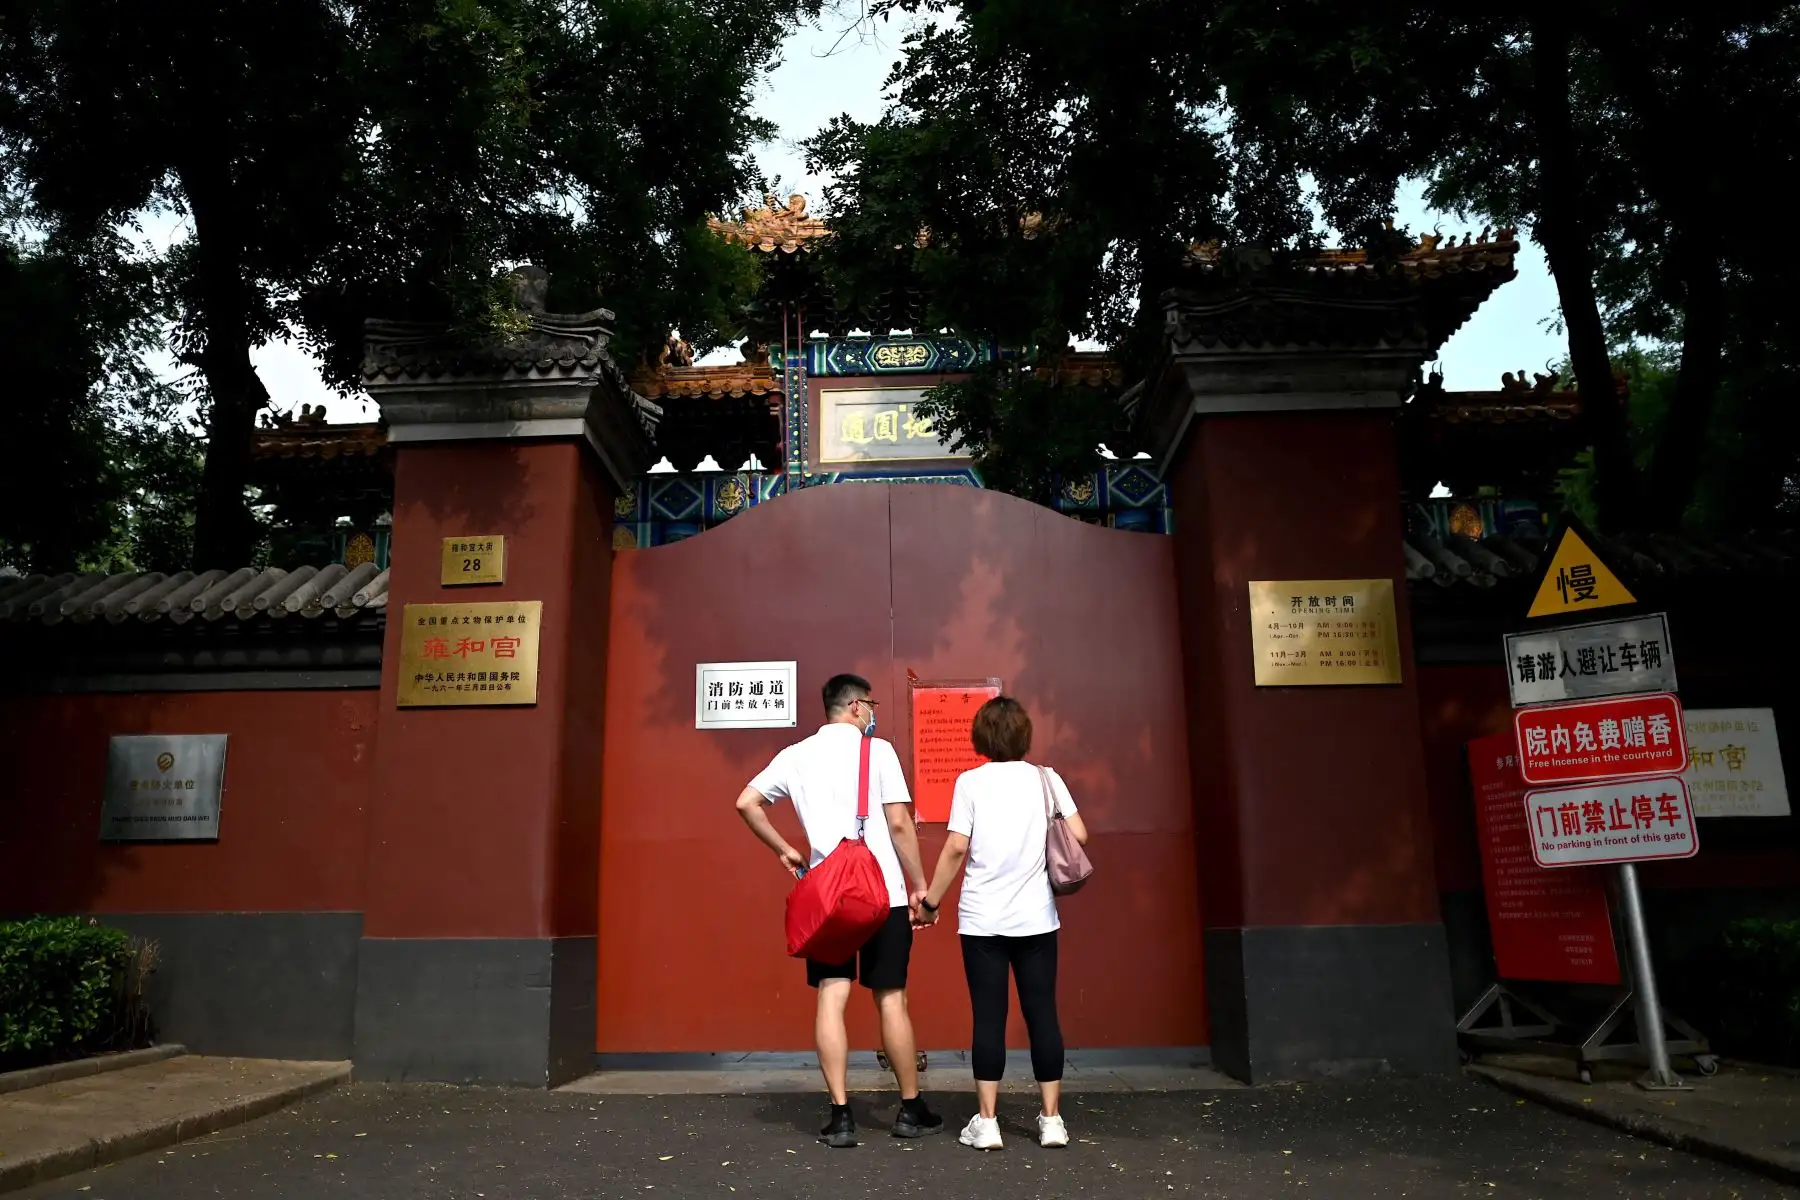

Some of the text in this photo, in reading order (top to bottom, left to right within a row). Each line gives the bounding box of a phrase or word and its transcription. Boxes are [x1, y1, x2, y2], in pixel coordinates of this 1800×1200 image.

[462, 558, 481, 572] 28
[1556, 563, 1599, 604] 慢
[1291, 595, 1354, 607] 开放时间
[417, 615, 526, 625] 全国重点文物保护单位
[420, 636, 521, 660] 雍和宫
[1516, 639, 1663, 683] 请游人避让车辆
[415, 671, 520, 682] 中华人民共和国国务院
[708, 680, 784, 697] 消防通道
[708, 698, 785, 710] 门前禁放车辆
[1525, 713, 1672, 757] 院内免费赠香
[1529, 748, 1672, 768] Free Incense in the courtyard
[1536, 792, 1682, 838] 门前禁止停车
[1541, 842, 1555, 851] No
[1557, 838, 1591, 851] parking
[1593, 837, 1602, 847] in
[1604, 836, 1628, 847] front
[1631, 834, 1641, 844] of
[1643, 832, 1661, 843] this
[1664, 832, 1687, 844] gate
